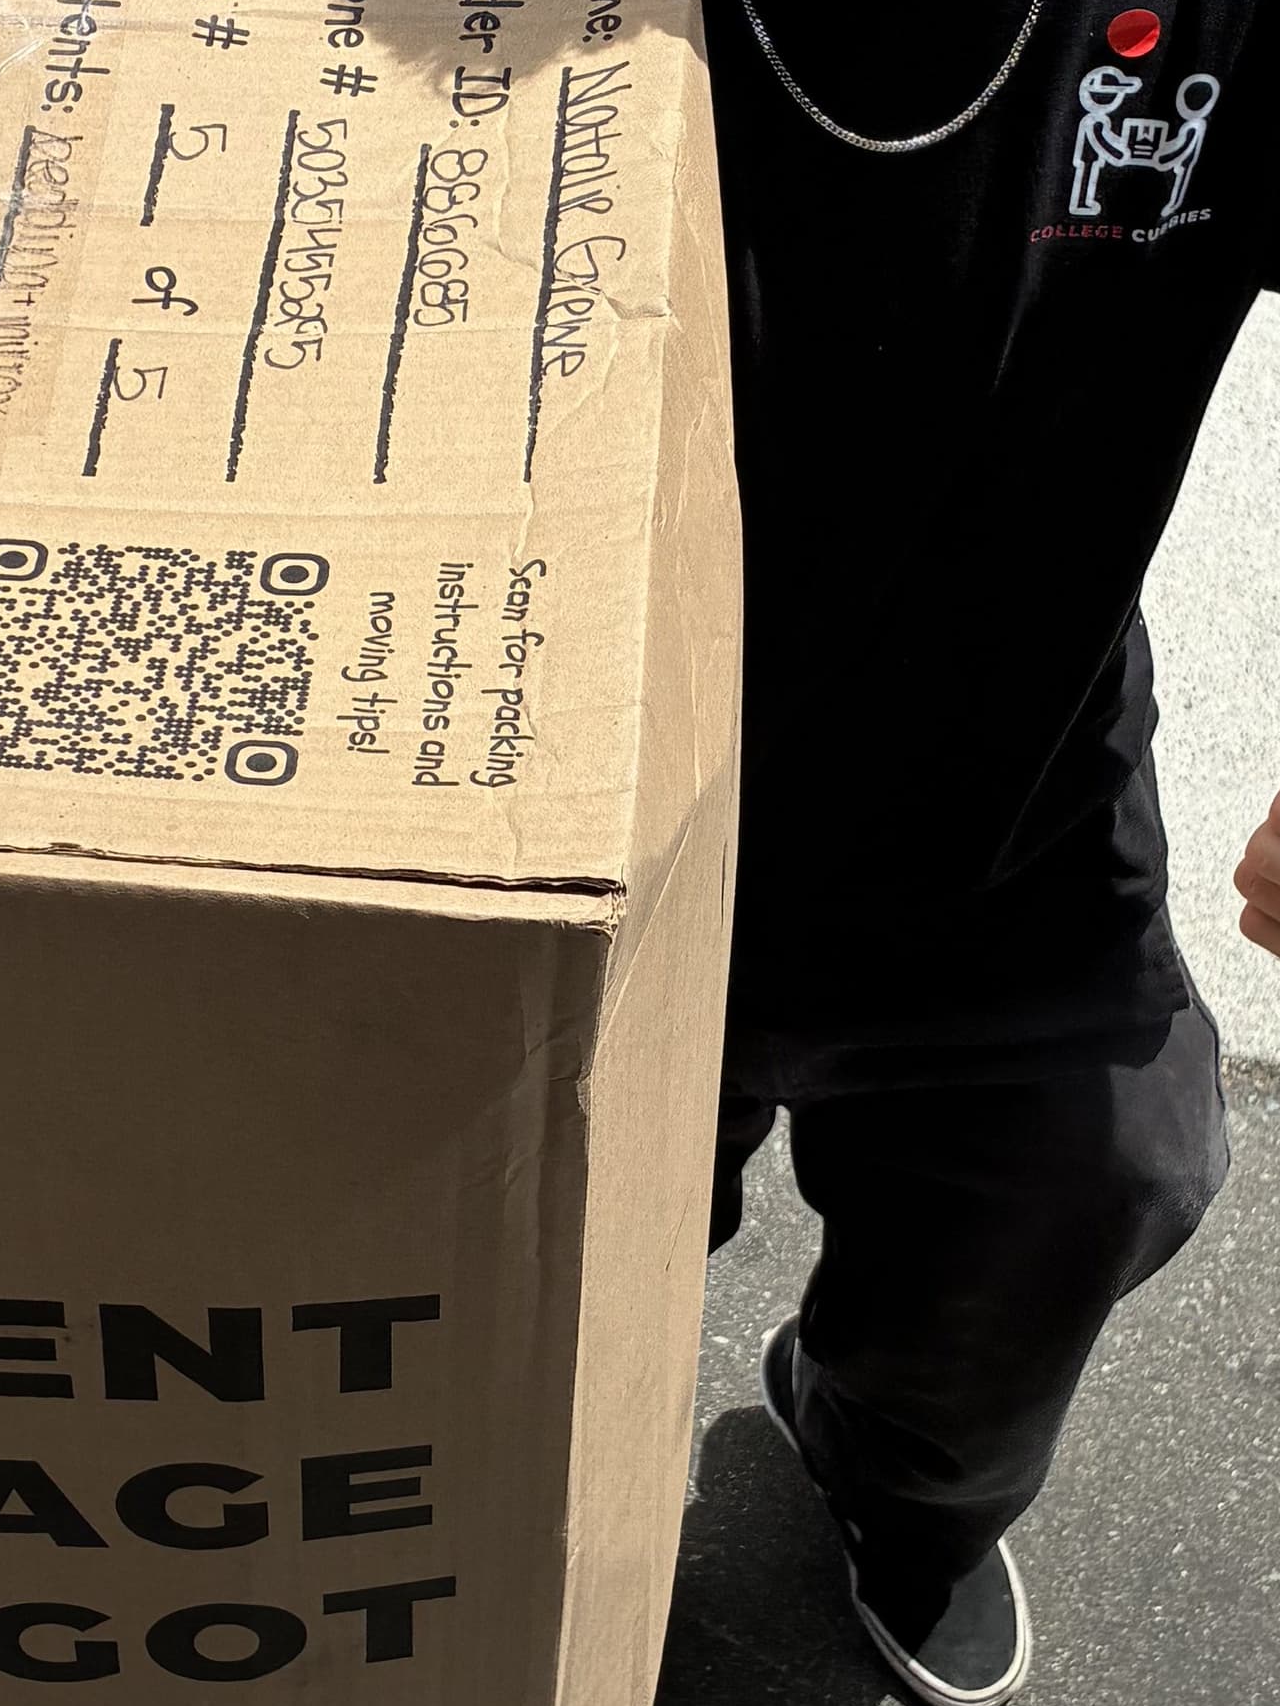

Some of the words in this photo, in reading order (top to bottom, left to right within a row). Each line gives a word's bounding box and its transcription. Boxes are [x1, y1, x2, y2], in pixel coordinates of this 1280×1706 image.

[190, 13, 251, 51] #
[318, 62, 379, 98] #
[447, 64, 515, 129] ID:
[162, 122, 228, 161] 5
[556, 59, 633, 224] Natalie
[411, 146, 489, 328] 886685
[129, 264, 200, 317] of
[106, 364, 169, 402] 5
[499, 553, 548, 623] Scan
[339, 590, 396, 683] moving
[420, 561, 480, 732] instructions
[496, 627, 545, 680] for
[334, 690, 399, 755] tips!
[468, 686, 538, 789] packing
[410, 738, 461, 787] and
